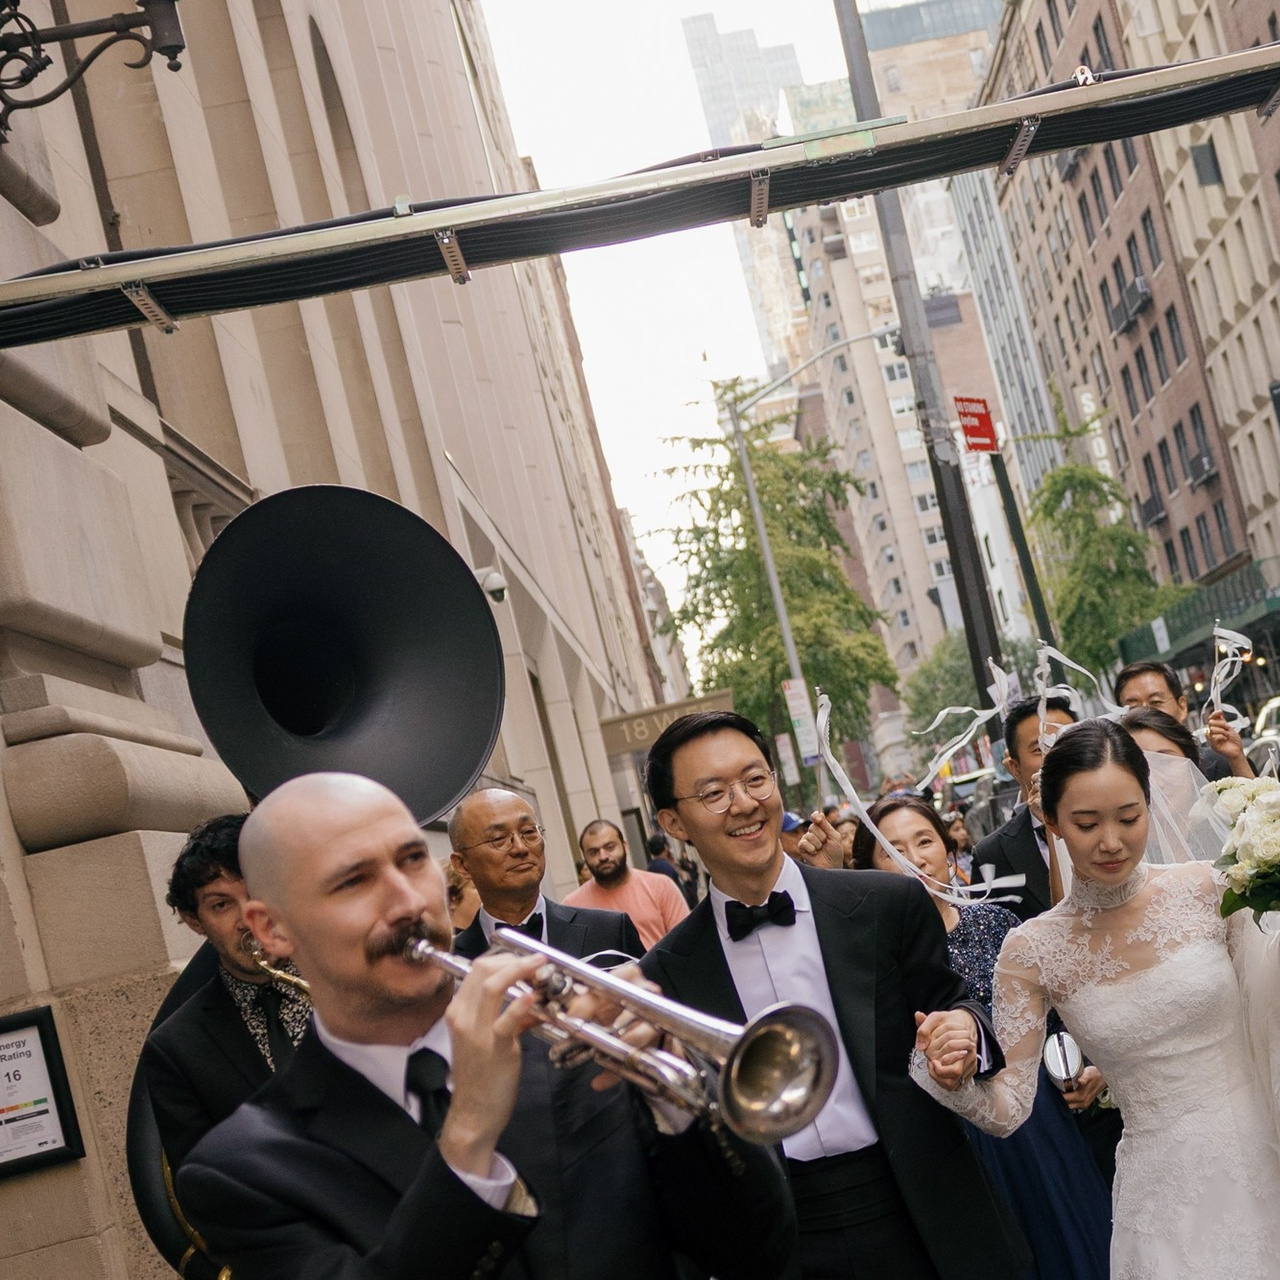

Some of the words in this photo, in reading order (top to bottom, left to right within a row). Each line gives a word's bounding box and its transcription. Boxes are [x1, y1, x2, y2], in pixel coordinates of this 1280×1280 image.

[619, 719, 649, 744] 18
[0, 1050, 32, 1063] Rating
[4, 1069, 22, 1083] 16
